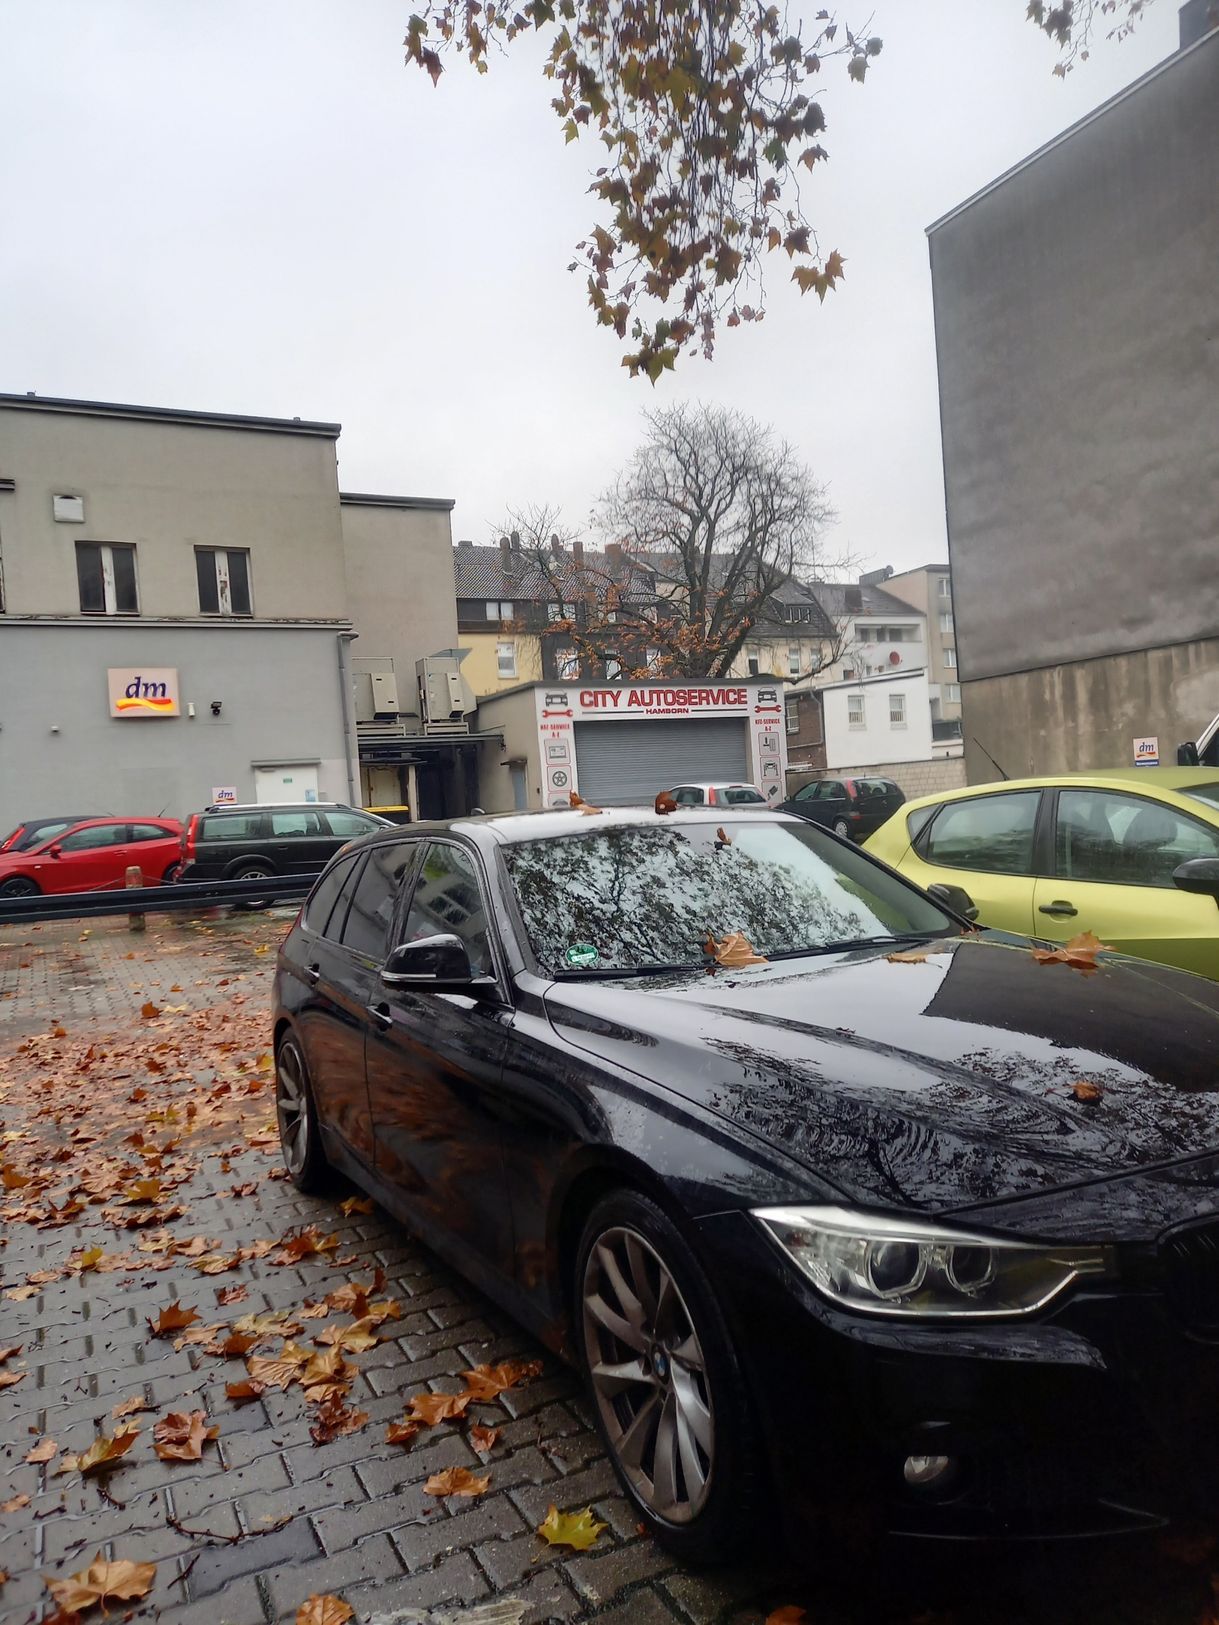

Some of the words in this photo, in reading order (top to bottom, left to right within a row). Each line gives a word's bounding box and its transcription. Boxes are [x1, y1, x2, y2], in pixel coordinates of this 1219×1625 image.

[125, 676, 166, 699] dm
[579, 690, 622, 708] CITY
[627, 688, 748, 707] AUTOSERVICE
[1139, 742, 1154, 752] dm
[218, 789, 233, 798] dm
